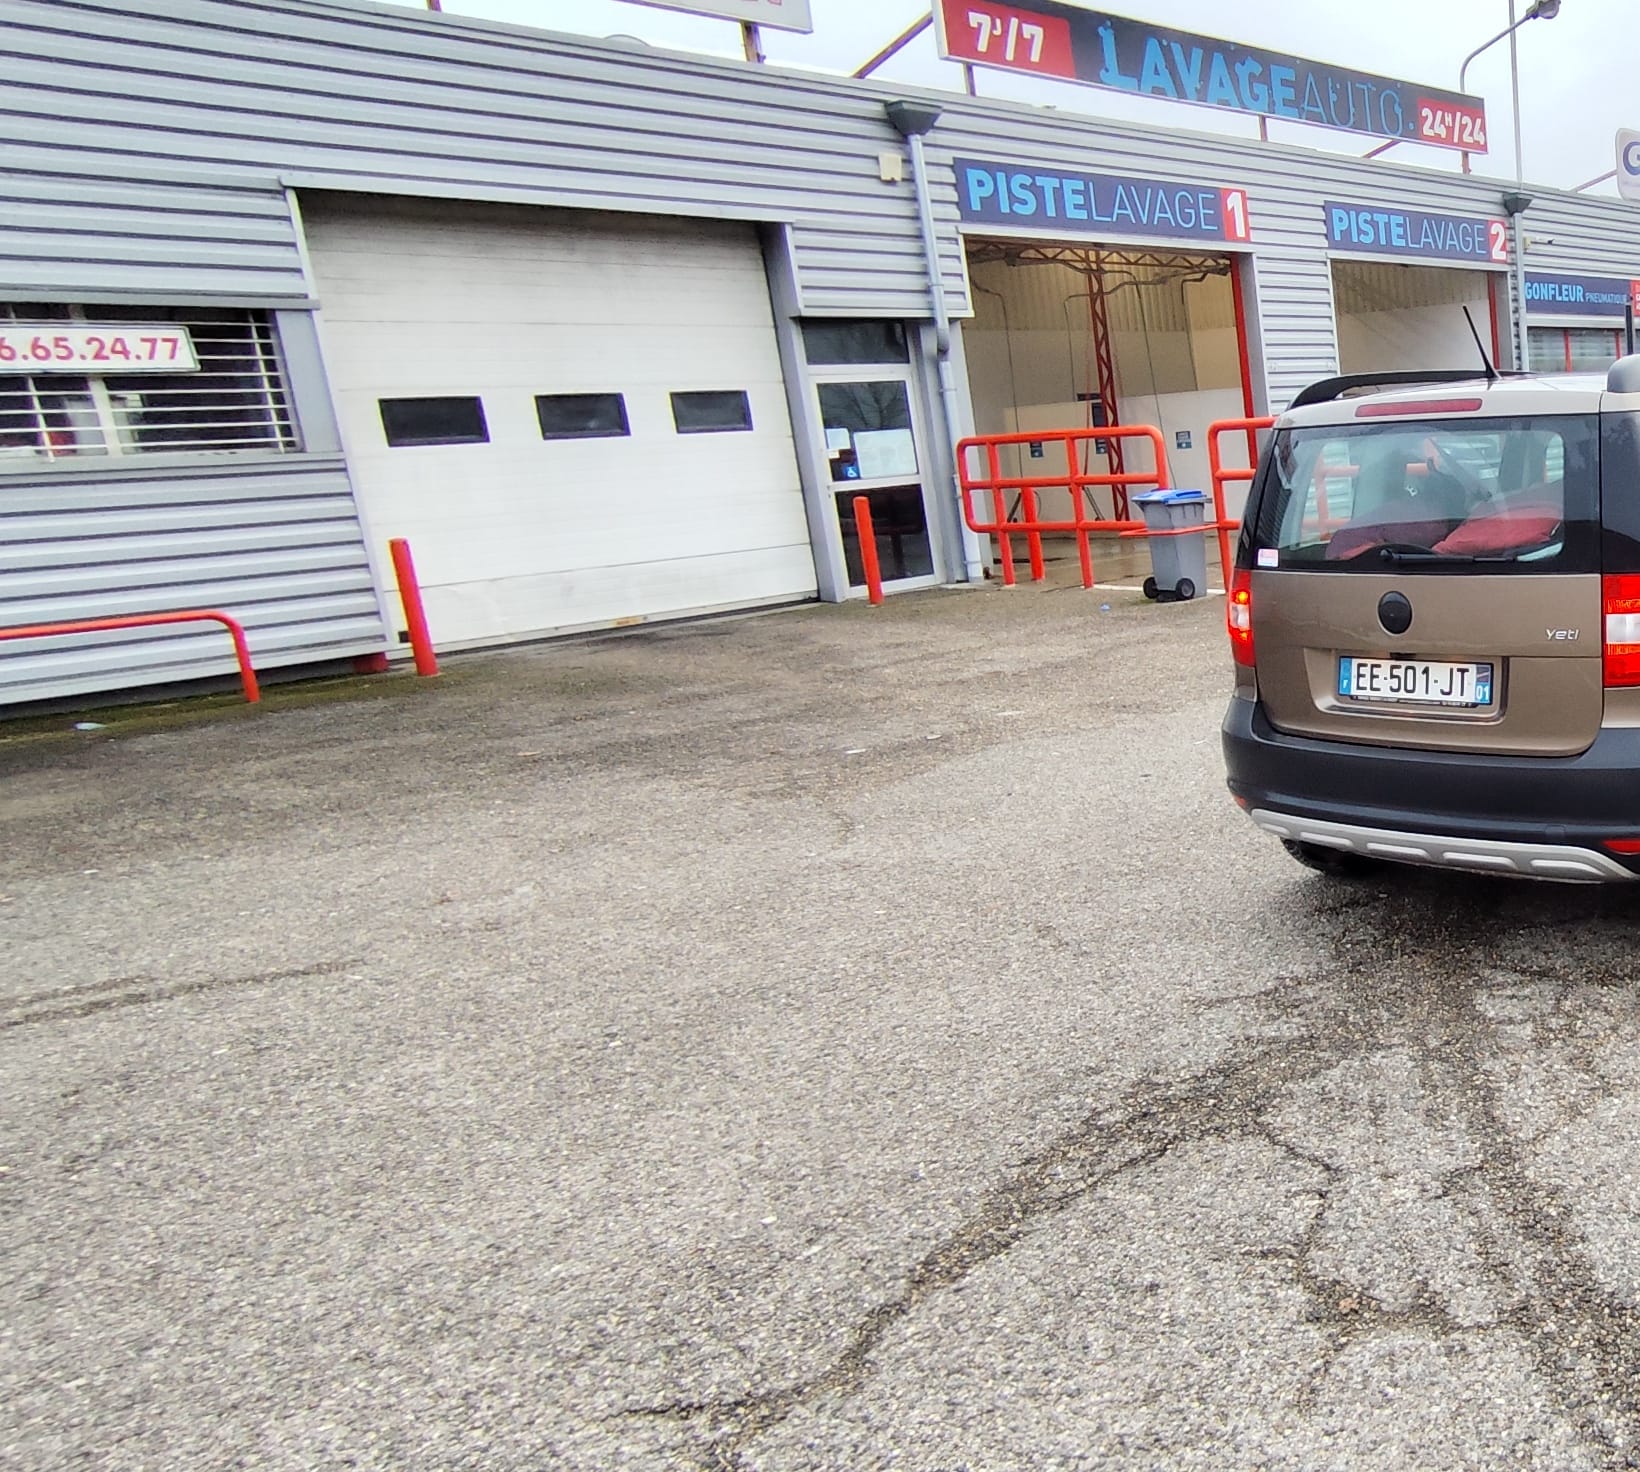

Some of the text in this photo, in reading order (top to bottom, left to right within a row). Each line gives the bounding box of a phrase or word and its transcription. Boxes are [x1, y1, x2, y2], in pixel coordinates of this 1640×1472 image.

[1226, 191, 1246, 238] 1
[1490, 222, 1507, 260] 2
[1525, 282, 1584, 302] GONFLEUR
[1476, 686, 1489, 701] 01
